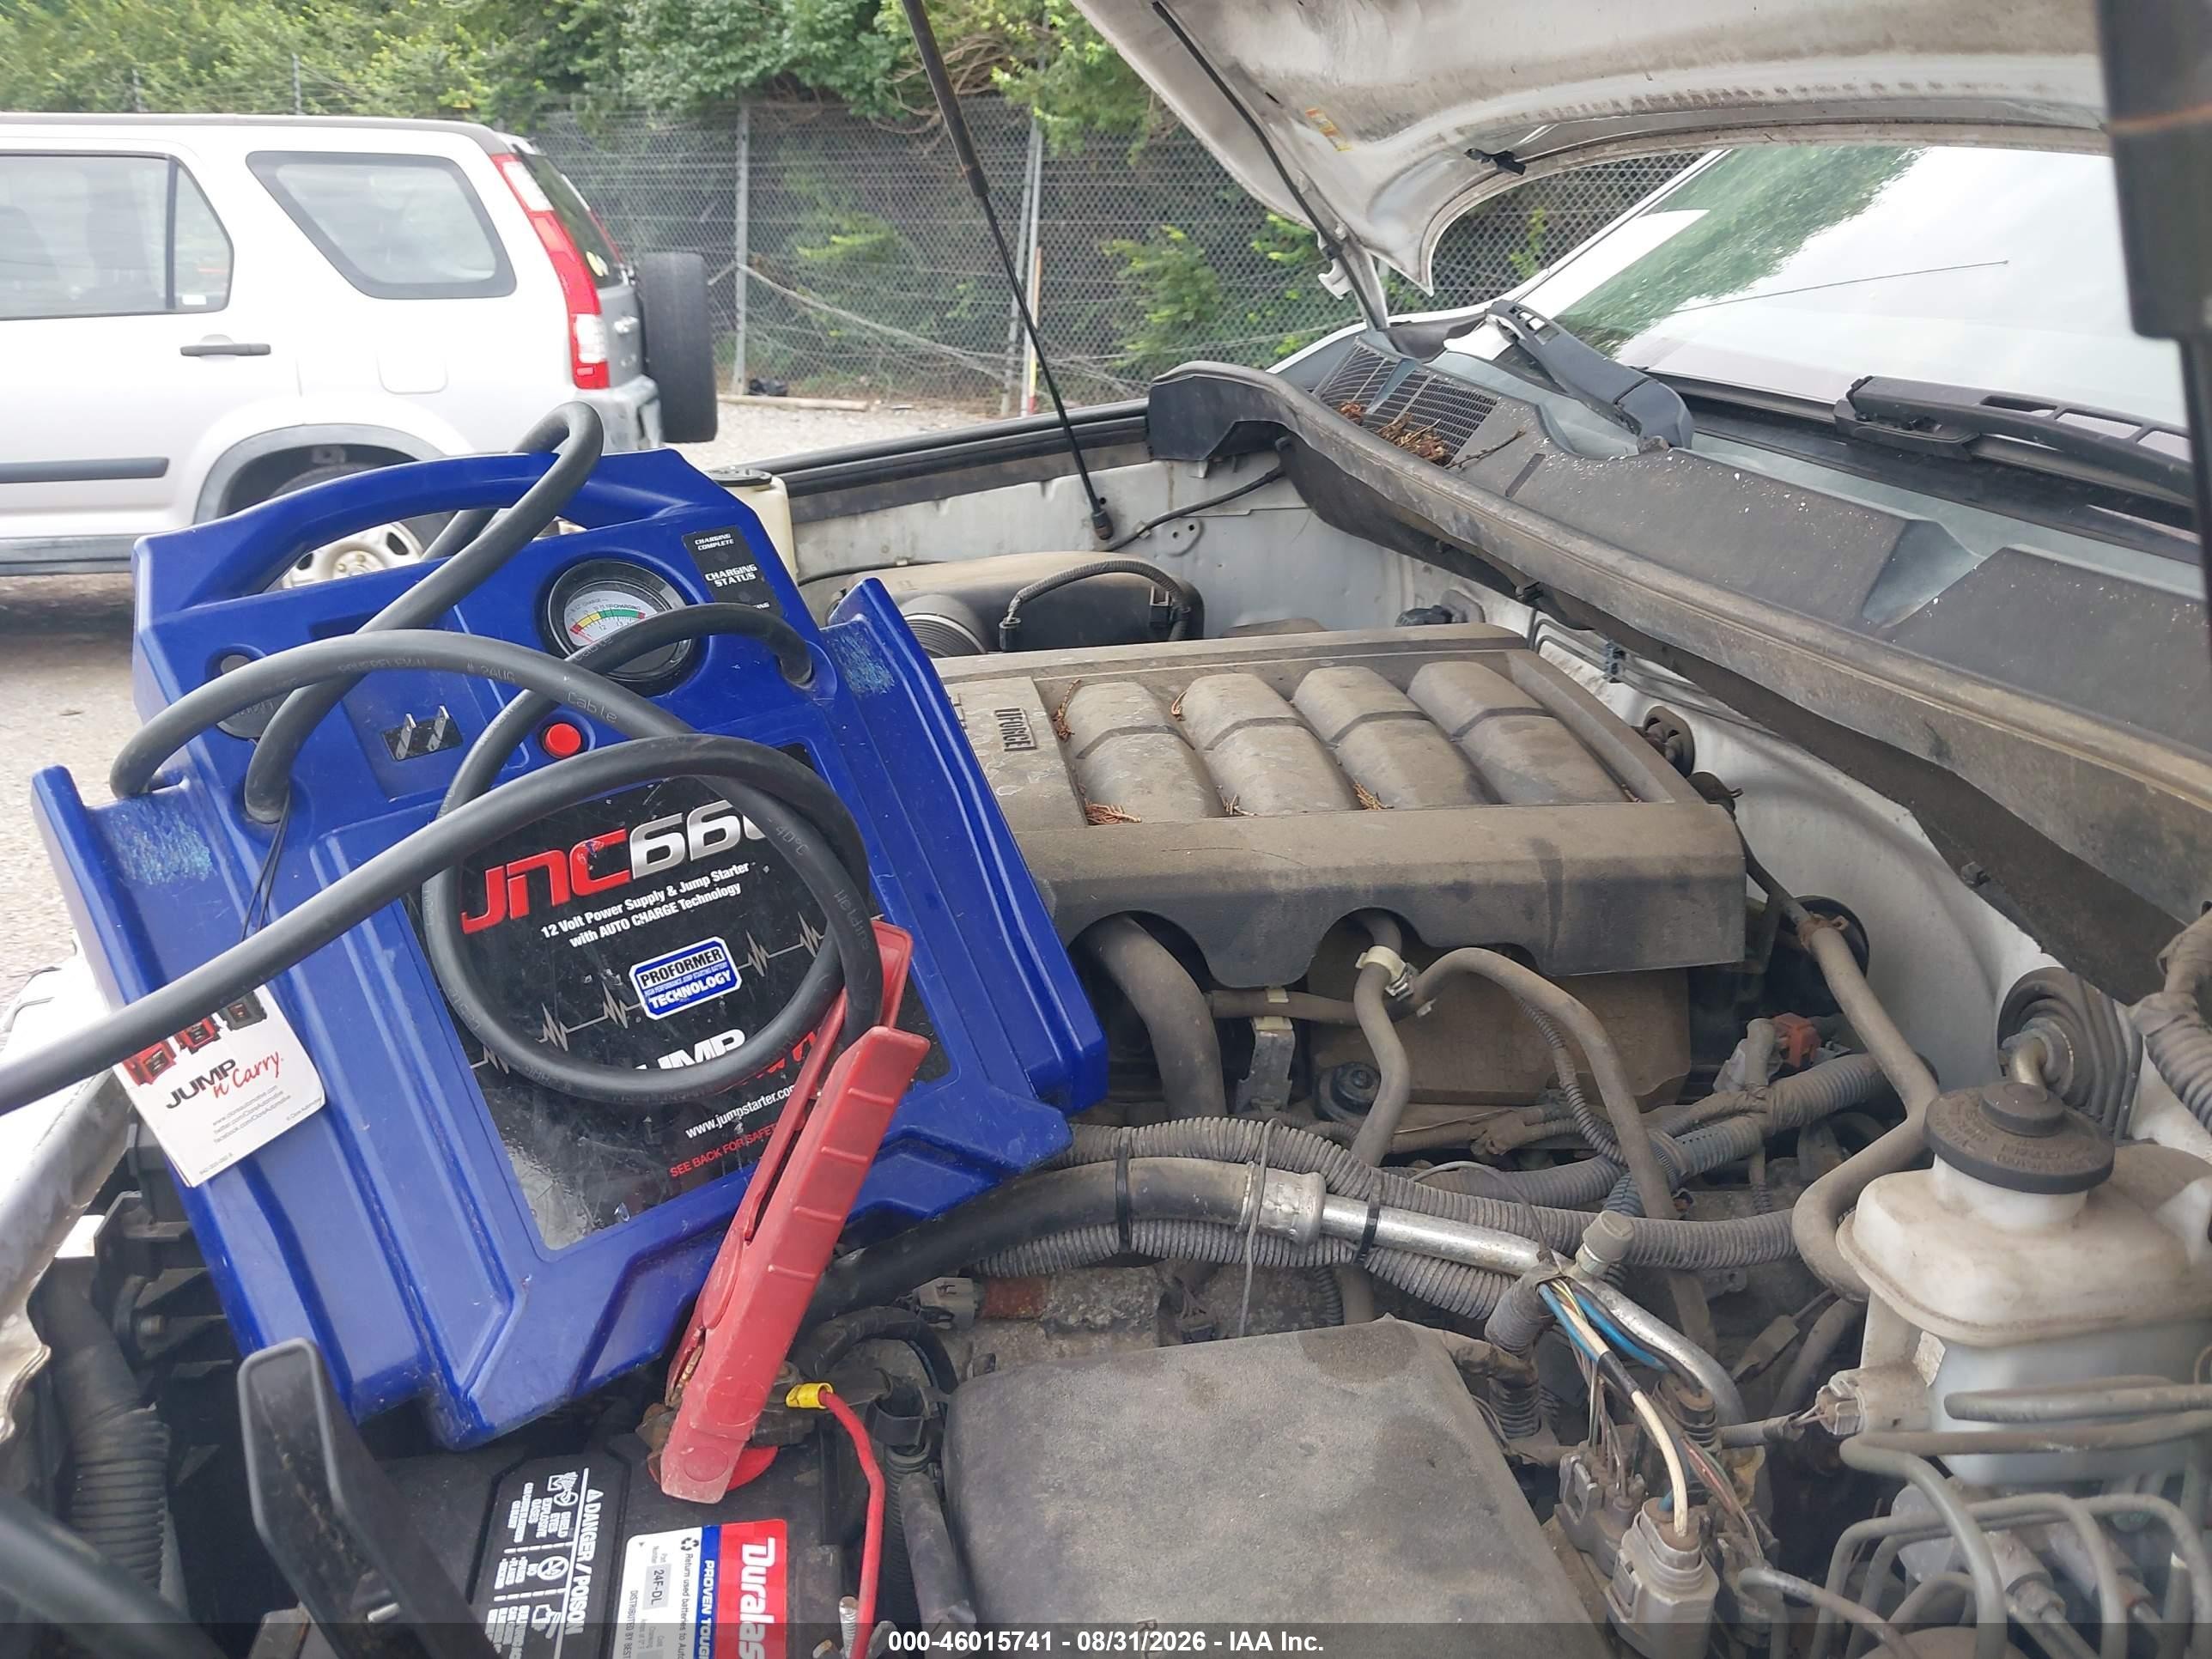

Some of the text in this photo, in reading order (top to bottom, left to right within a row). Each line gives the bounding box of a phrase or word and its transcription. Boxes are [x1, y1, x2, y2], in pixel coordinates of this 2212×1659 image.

[695, 533, 732, 545] CHARGING
[697, 538, 735, 550] COMPLETE
[705, 563, 757, 581] CHARGING
[714, 572, 757, 587] STATUS
[567, 692, 617, 724] Cable
[460, 799, 767, 934] JNC66
[540, 862, 750, 939] 12 Volt Power Supply & Jump Starter
[569, 882, 742, 948] with AUTO CHARGE Technology
[640, 948, 722, 987] PROFORMER
[649, 969, 732, 1009] TECHNOLOGY
[166, 1059, 236, 1109] JUMP
[233, 1051, 279, 1088] Carry
[670, 1161, 691, 1177] SEE
[692, 1149, 723, 1169] BACK
[722, 1138, 744, 1155] FOR
[684, 1553, 694, 1578] Return
[651, 1569, 665, 1606] 24F-DL
[682, 1578, 691, 1596] used
[701, 1559, 715, 1615] PROVEN
[679, 1598, 690, 1631] batteries
[678, 1632, 688, 1641] to
